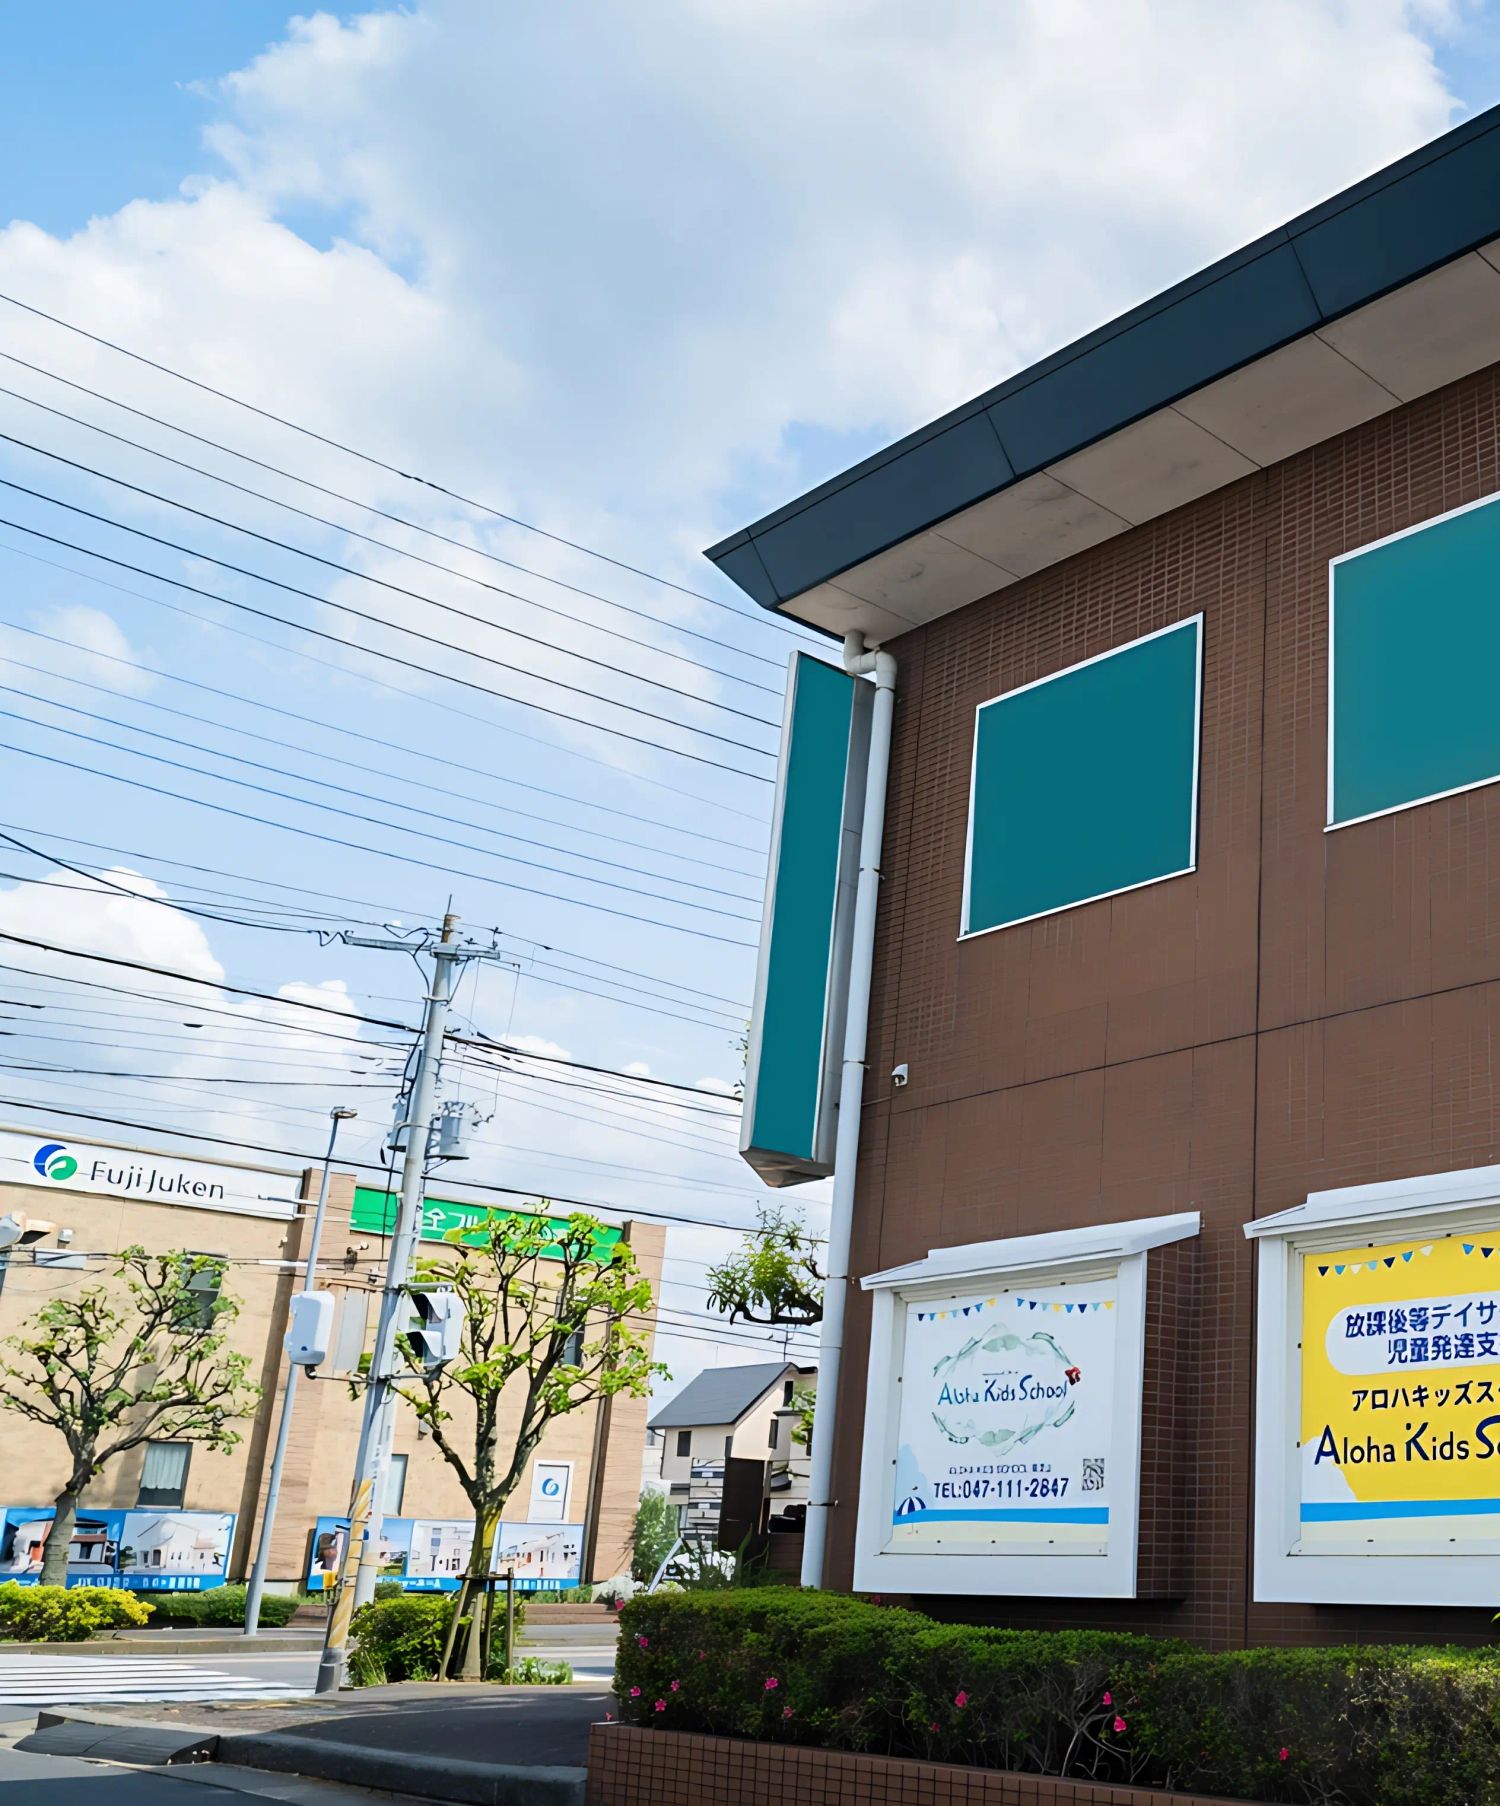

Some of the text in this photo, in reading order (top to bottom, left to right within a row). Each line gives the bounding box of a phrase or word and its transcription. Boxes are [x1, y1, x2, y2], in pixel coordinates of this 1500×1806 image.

[91, 1160, 225, 1199] Fuji Juken
[984, 1378, 1016, 1402] Kids
[1019, 1374, 1068, 1401] School
[1314, 1424, 1396, 1465] Aloha
[1405, 1422, 1470, 1462] Kids
